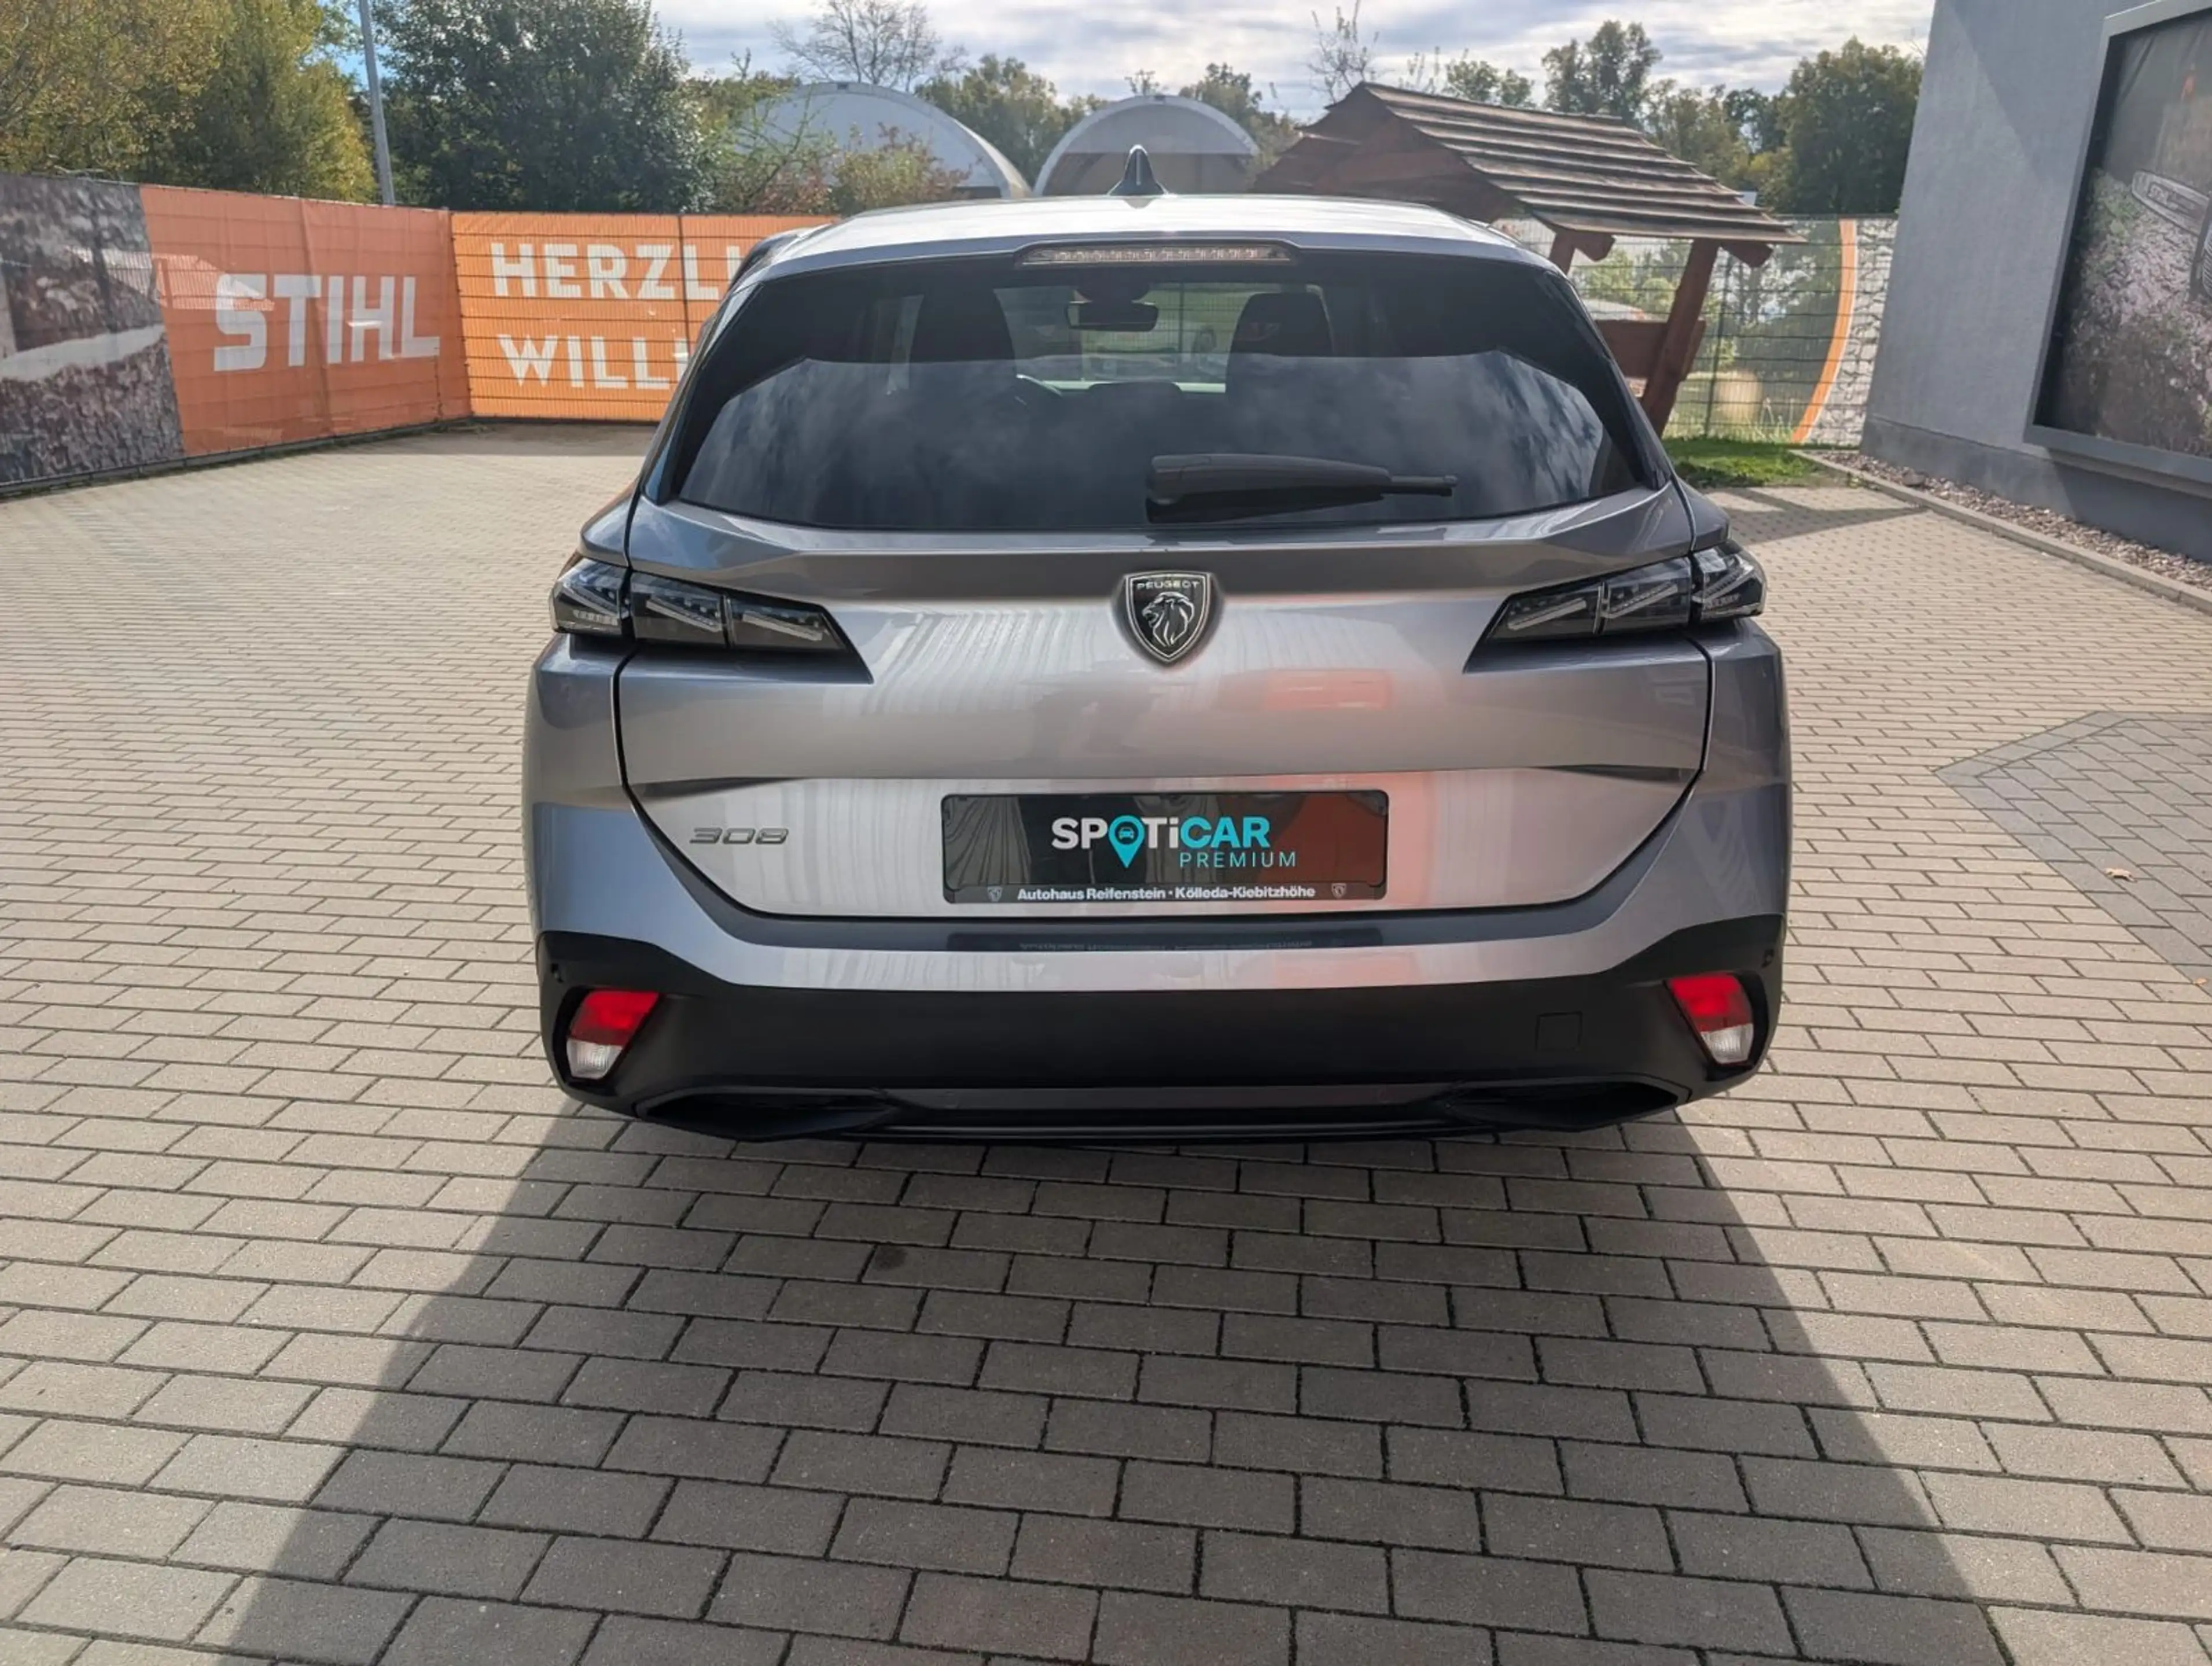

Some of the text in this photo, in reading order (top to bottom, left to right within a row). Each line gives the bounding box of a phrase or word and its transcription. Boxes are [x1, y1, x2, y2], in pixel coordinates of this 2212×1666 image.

[213, 273, 440, 372] STIHL
[497, 334, 689, 390] WILL
[1136, 579, 1200, 589] PEUGEOT
[689, 827, 789, 845] 308
[1180, 852, 1296, 868] PREMIUM
[1017, 886, 1316, 900] Autohaus Reifenstein Kölleda-Kiebitzhöhe
